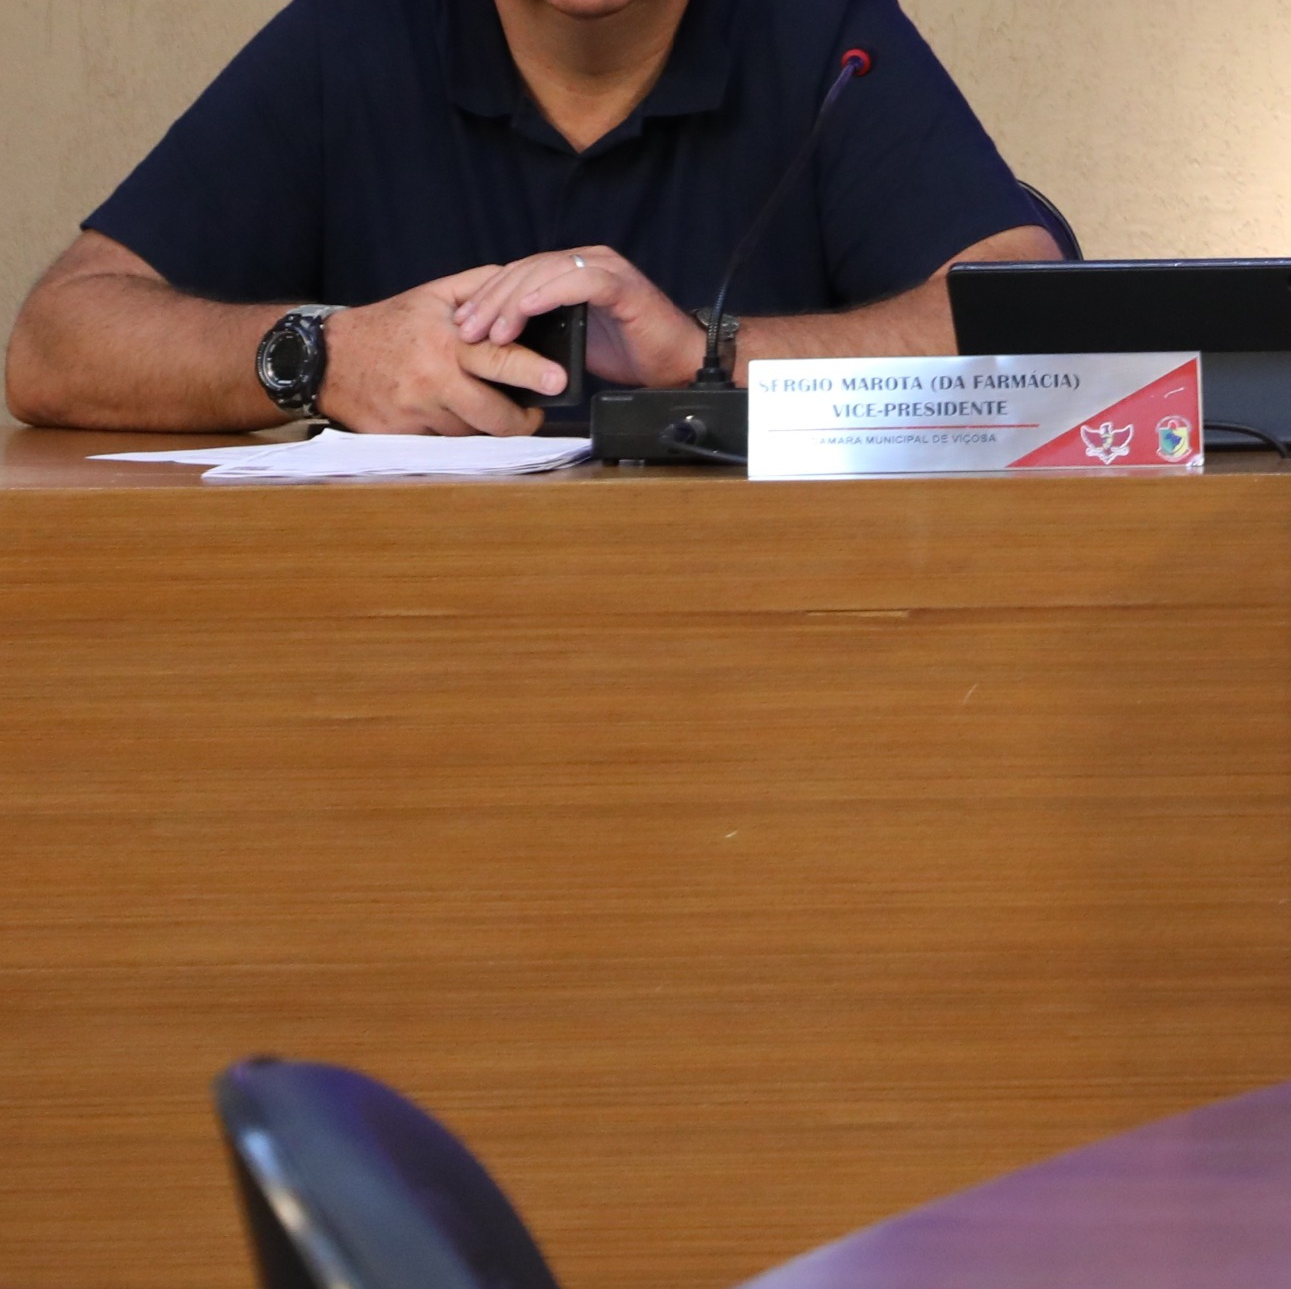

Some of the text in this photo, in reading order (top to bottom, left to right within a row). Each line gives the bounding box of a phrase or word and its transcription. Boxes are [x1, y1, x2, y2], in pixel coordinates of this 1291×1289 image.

[842, 376, 923, 391] MAROTA
[931, 375, 965, 392] (DA
[973, 370, 1080, 390] FARMÁCIA)
[833, 400, 1008, 417] VICE-PRESIDENTE
[865, 434, 929, 445] MUNICIPAL
[932, 434, 948, 443] DE
[952, 434, 996, 445] VIÇOSA
